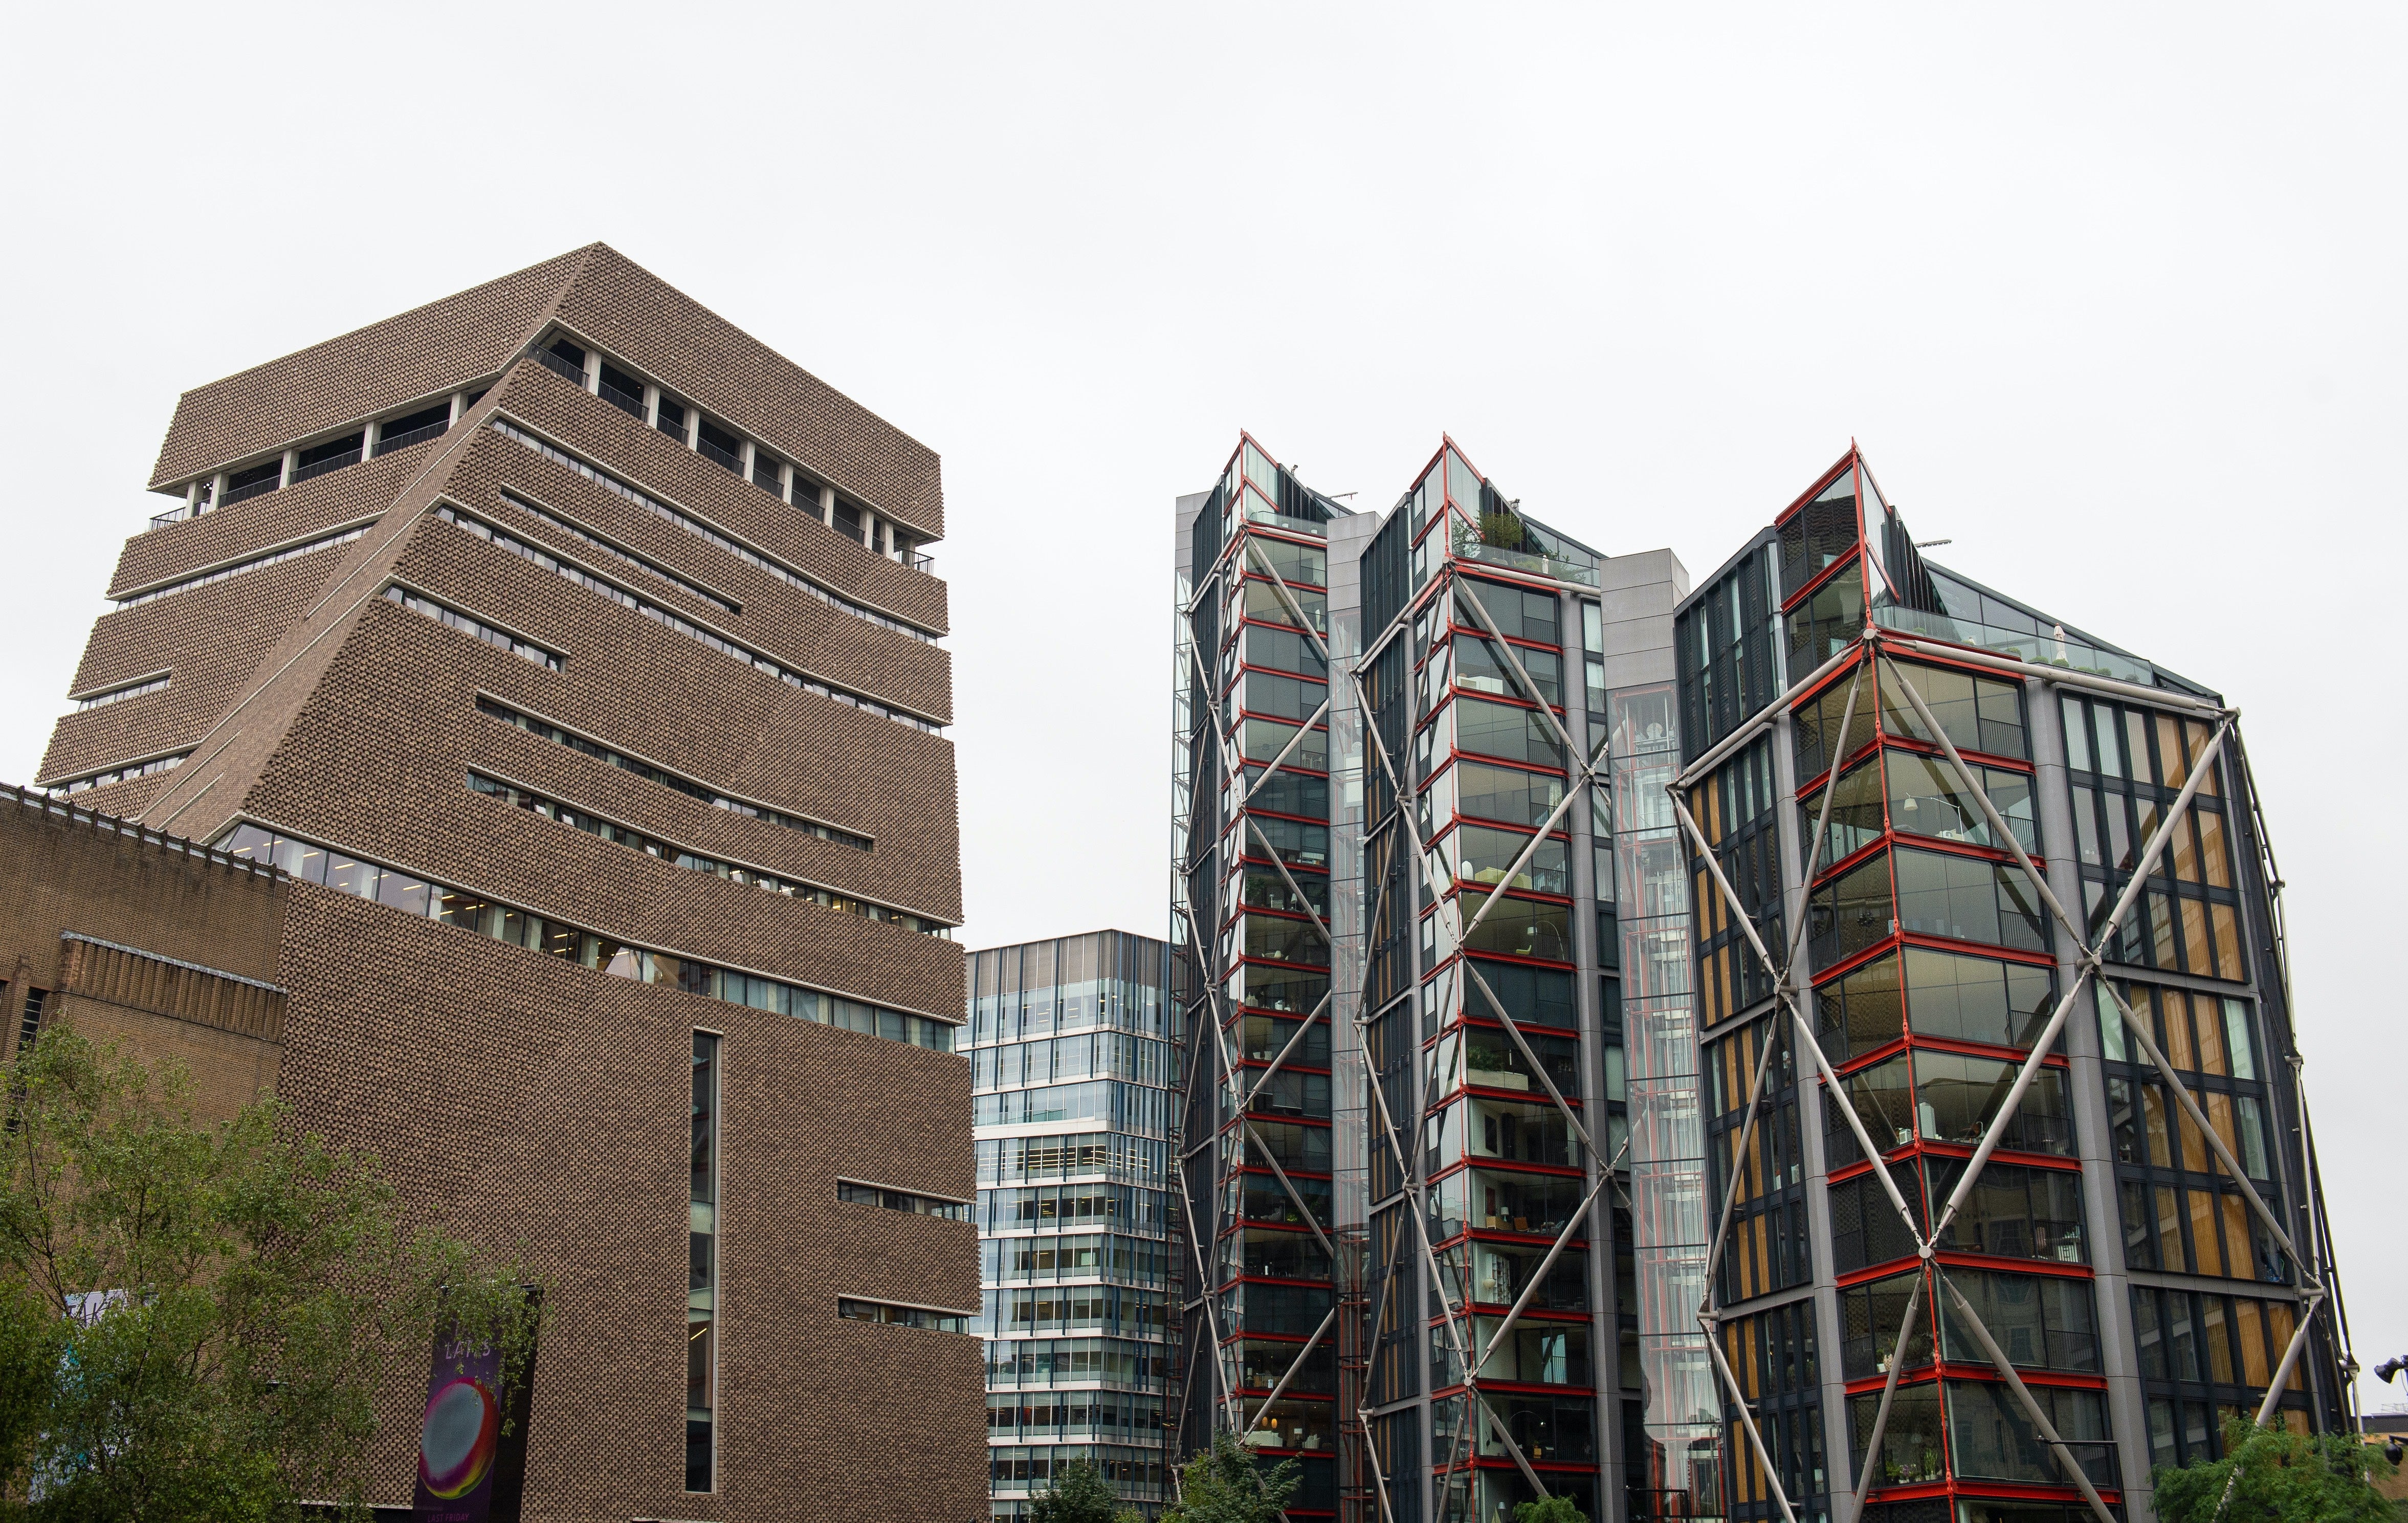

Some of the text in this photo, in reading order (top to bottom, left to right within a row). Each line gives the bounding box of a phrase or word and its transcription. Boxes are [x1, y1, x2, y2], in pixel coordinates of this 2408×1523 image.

[446, 1338, 491, 1359] LATS
[427, 1513, 469, 1522] LAST FRIDAY
